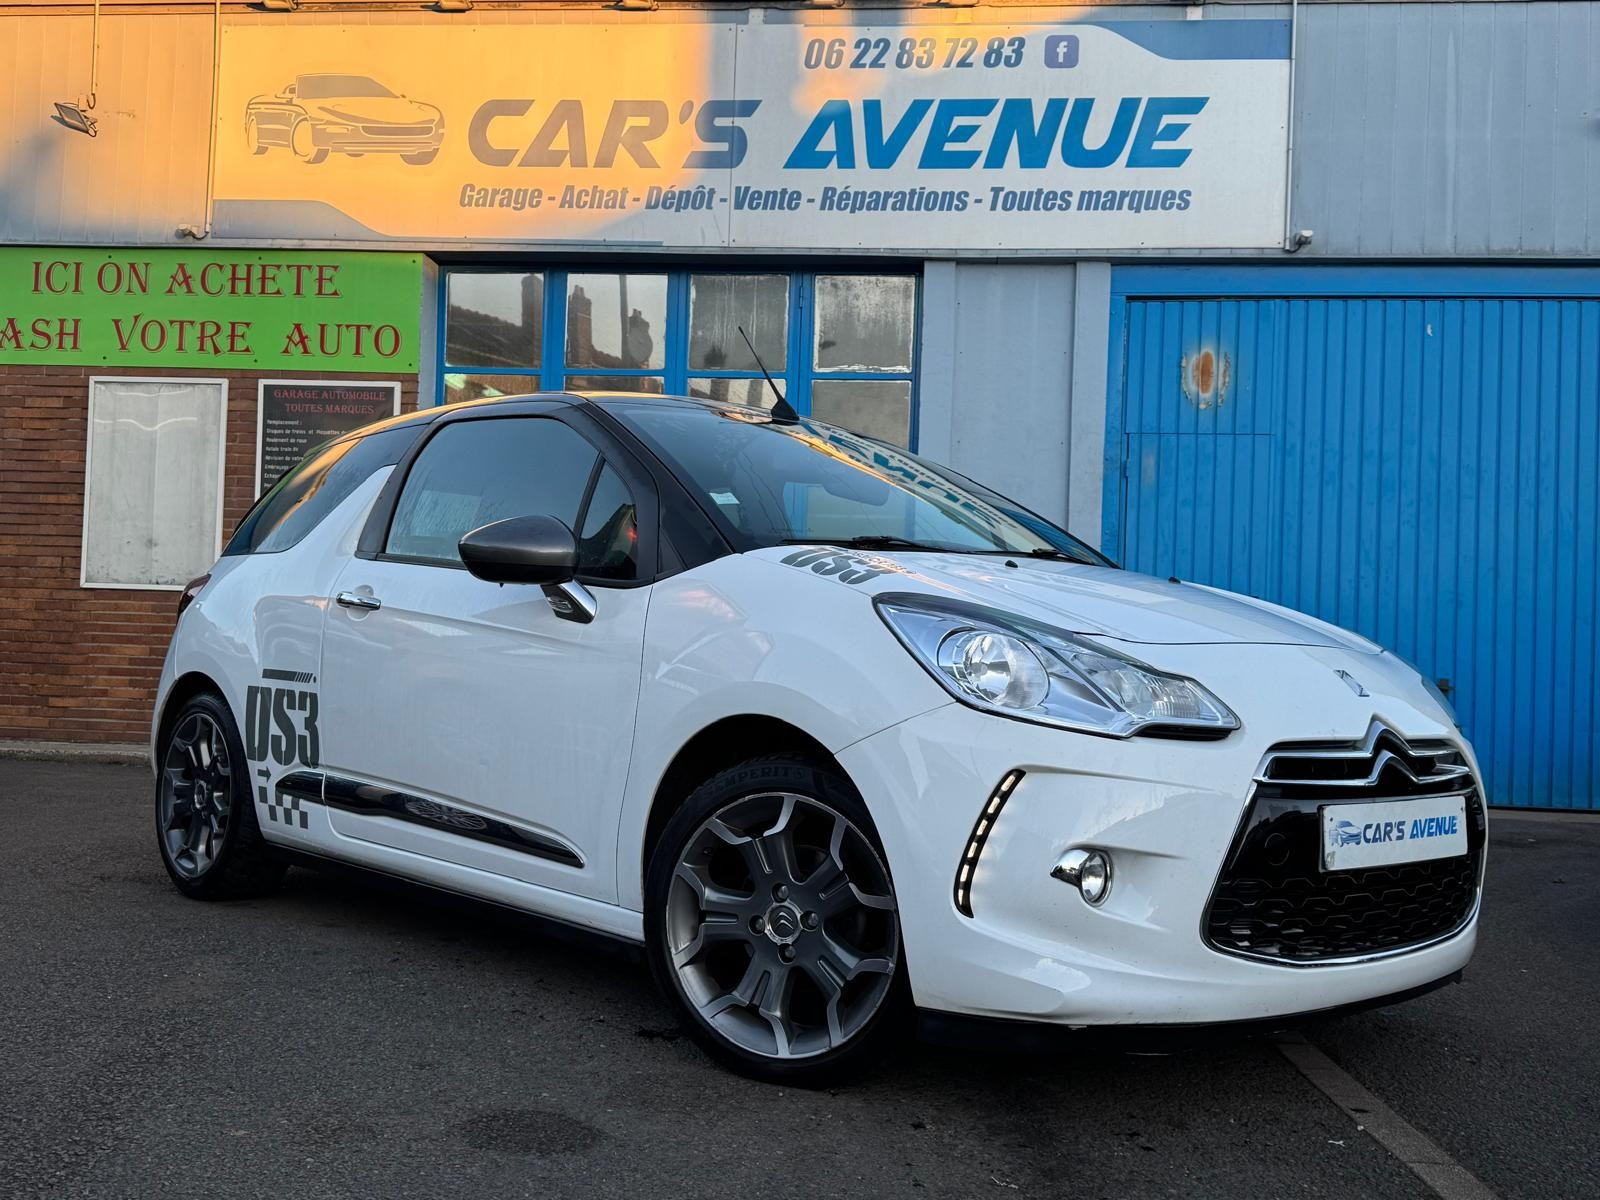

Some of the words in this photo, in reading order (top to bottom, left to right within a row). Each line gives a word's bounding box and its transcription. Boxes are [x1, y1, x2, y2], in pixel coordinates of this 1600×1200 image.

[804, 37, 846, 69] 06
[849, 37, 891, 69] 22
[895, 37, 937, 69] 83
[942, 37, 978, 68] 72
[983, 36, 1026, 68] 83
[468, 99, 763, 169] CAR'S
[782, 96, 1211, 169] AVENUE
[459, 183, 543, 211] Garage
[559, 184, 629, 209] Achat
[645, 185, 716, 212] Dépôt
[734, 186, 802, 211] Vente
[819, 185, 969, 214] Réparations
[989, 187, 1073, 211] Toutes
[1076, 189, 1192, 213] marques
[32, 261, 83, 295] ICI
[96, 261, 151, 296] ON
[165, 262, 342, 298] ACHETE
[111, 311, 253, 356] VOTRE
[281, 323, 401, 358] AUTO
[273, 389, 319, 399] GARAGE
[321, 390, 386, 401] AUTOMOBILE
[285, 403, 323, 413] TOUTES
[325, 404, 375, 414] MARQUES
[245, 685, 319, 769] DS3
[1363, 820, 1406, 844] CAR'S
[1409, 815, 1458, 840] AVENUE
